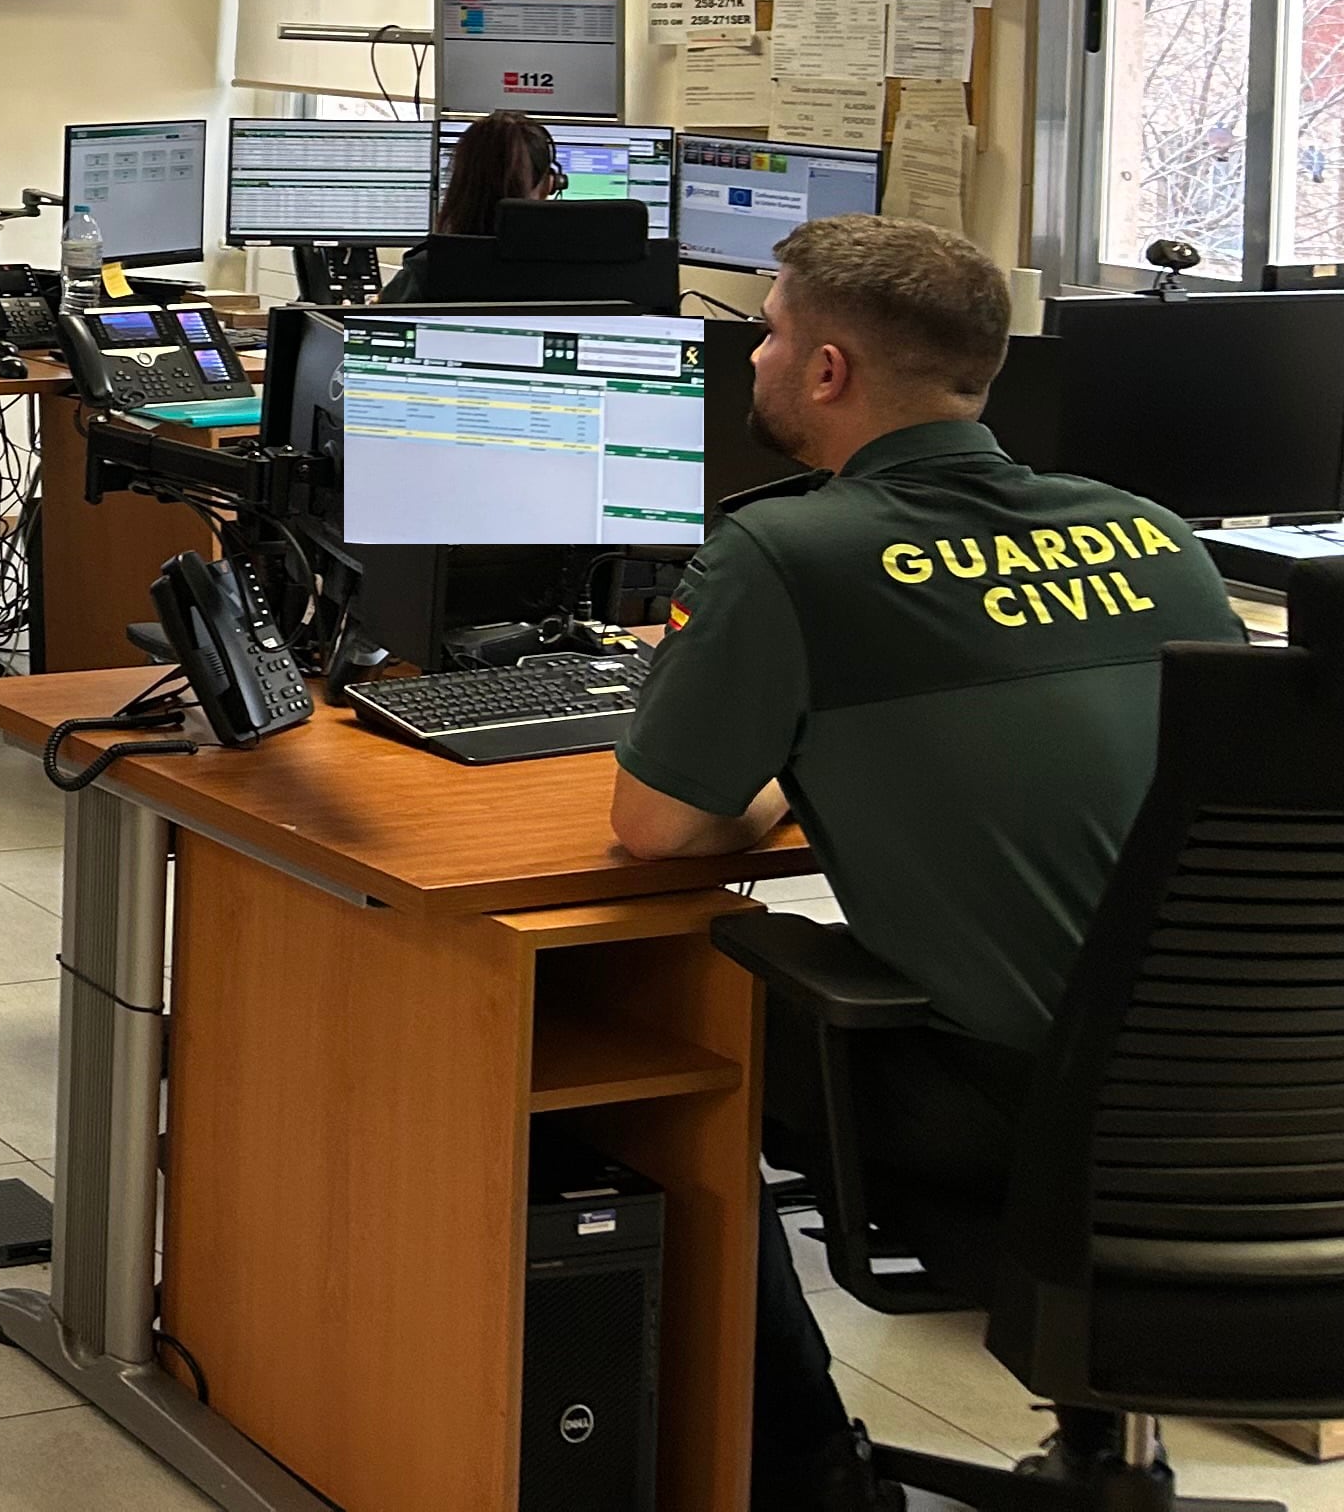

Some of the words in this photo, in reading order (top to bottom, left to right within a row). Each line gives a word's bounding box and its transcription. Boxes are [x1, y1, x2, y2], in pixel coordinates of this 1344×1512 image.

[690, 14, 752, 26] 258-271SER
[519, 73, 554, 87] 112
[881, 517, 1181, 584] GUARDIA
[983, 571, 1156, 627] CIVIL
